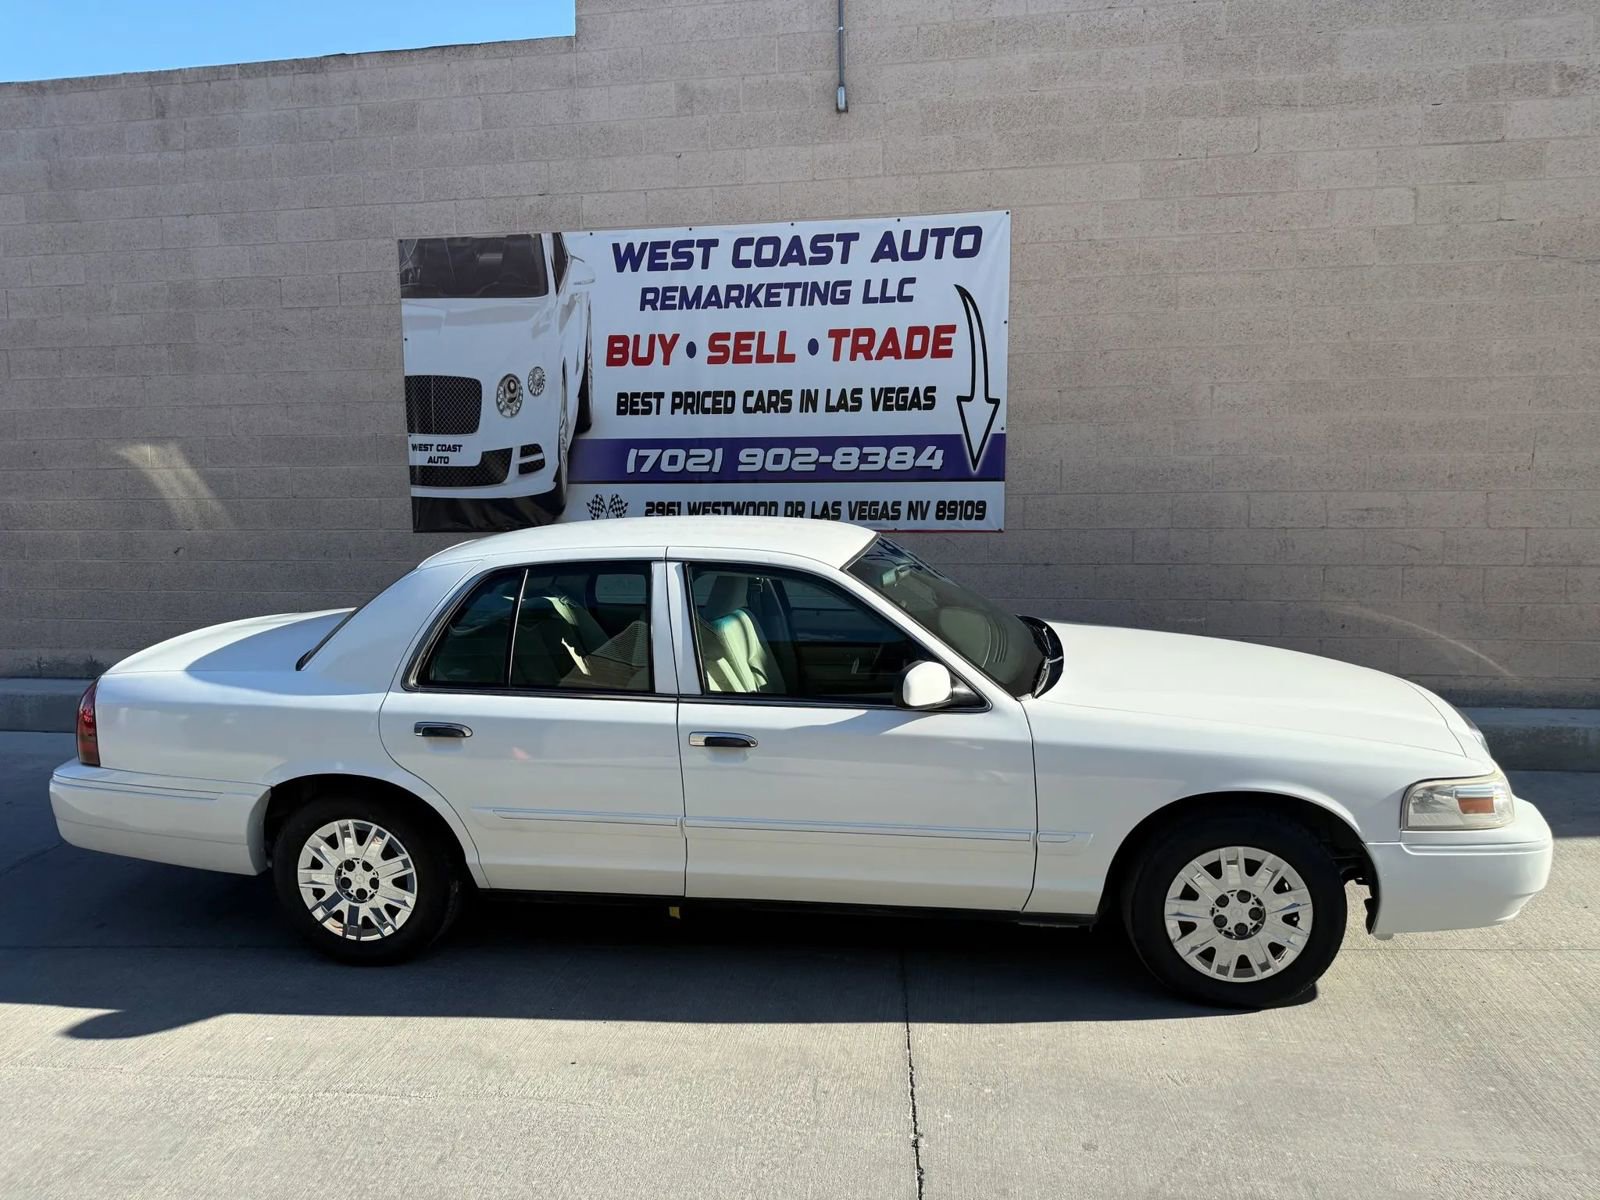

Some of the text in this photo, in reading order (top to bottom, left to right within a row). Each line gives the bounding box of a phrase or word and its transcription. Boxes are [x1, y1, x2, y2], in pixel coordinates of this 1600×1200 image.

[611, 225, 983, 273] WEST COAST AUTO
[639, 277, 917, 311] REMARKETING LLC
[605, 324, 957, 367] BUY SELL TRADE
[616, 385, 937, 416] BEST PRICED CARS IN LAS VEGAS
[411, 444, 463, 452] WEST COAST
[427, 456, 449, 464] AUTO
[626, 445, 944, 473] (702) 902-8384
[645, 500, 987, 521] 2961 WESTWOOD DR LAS VEGAS NV 89109
